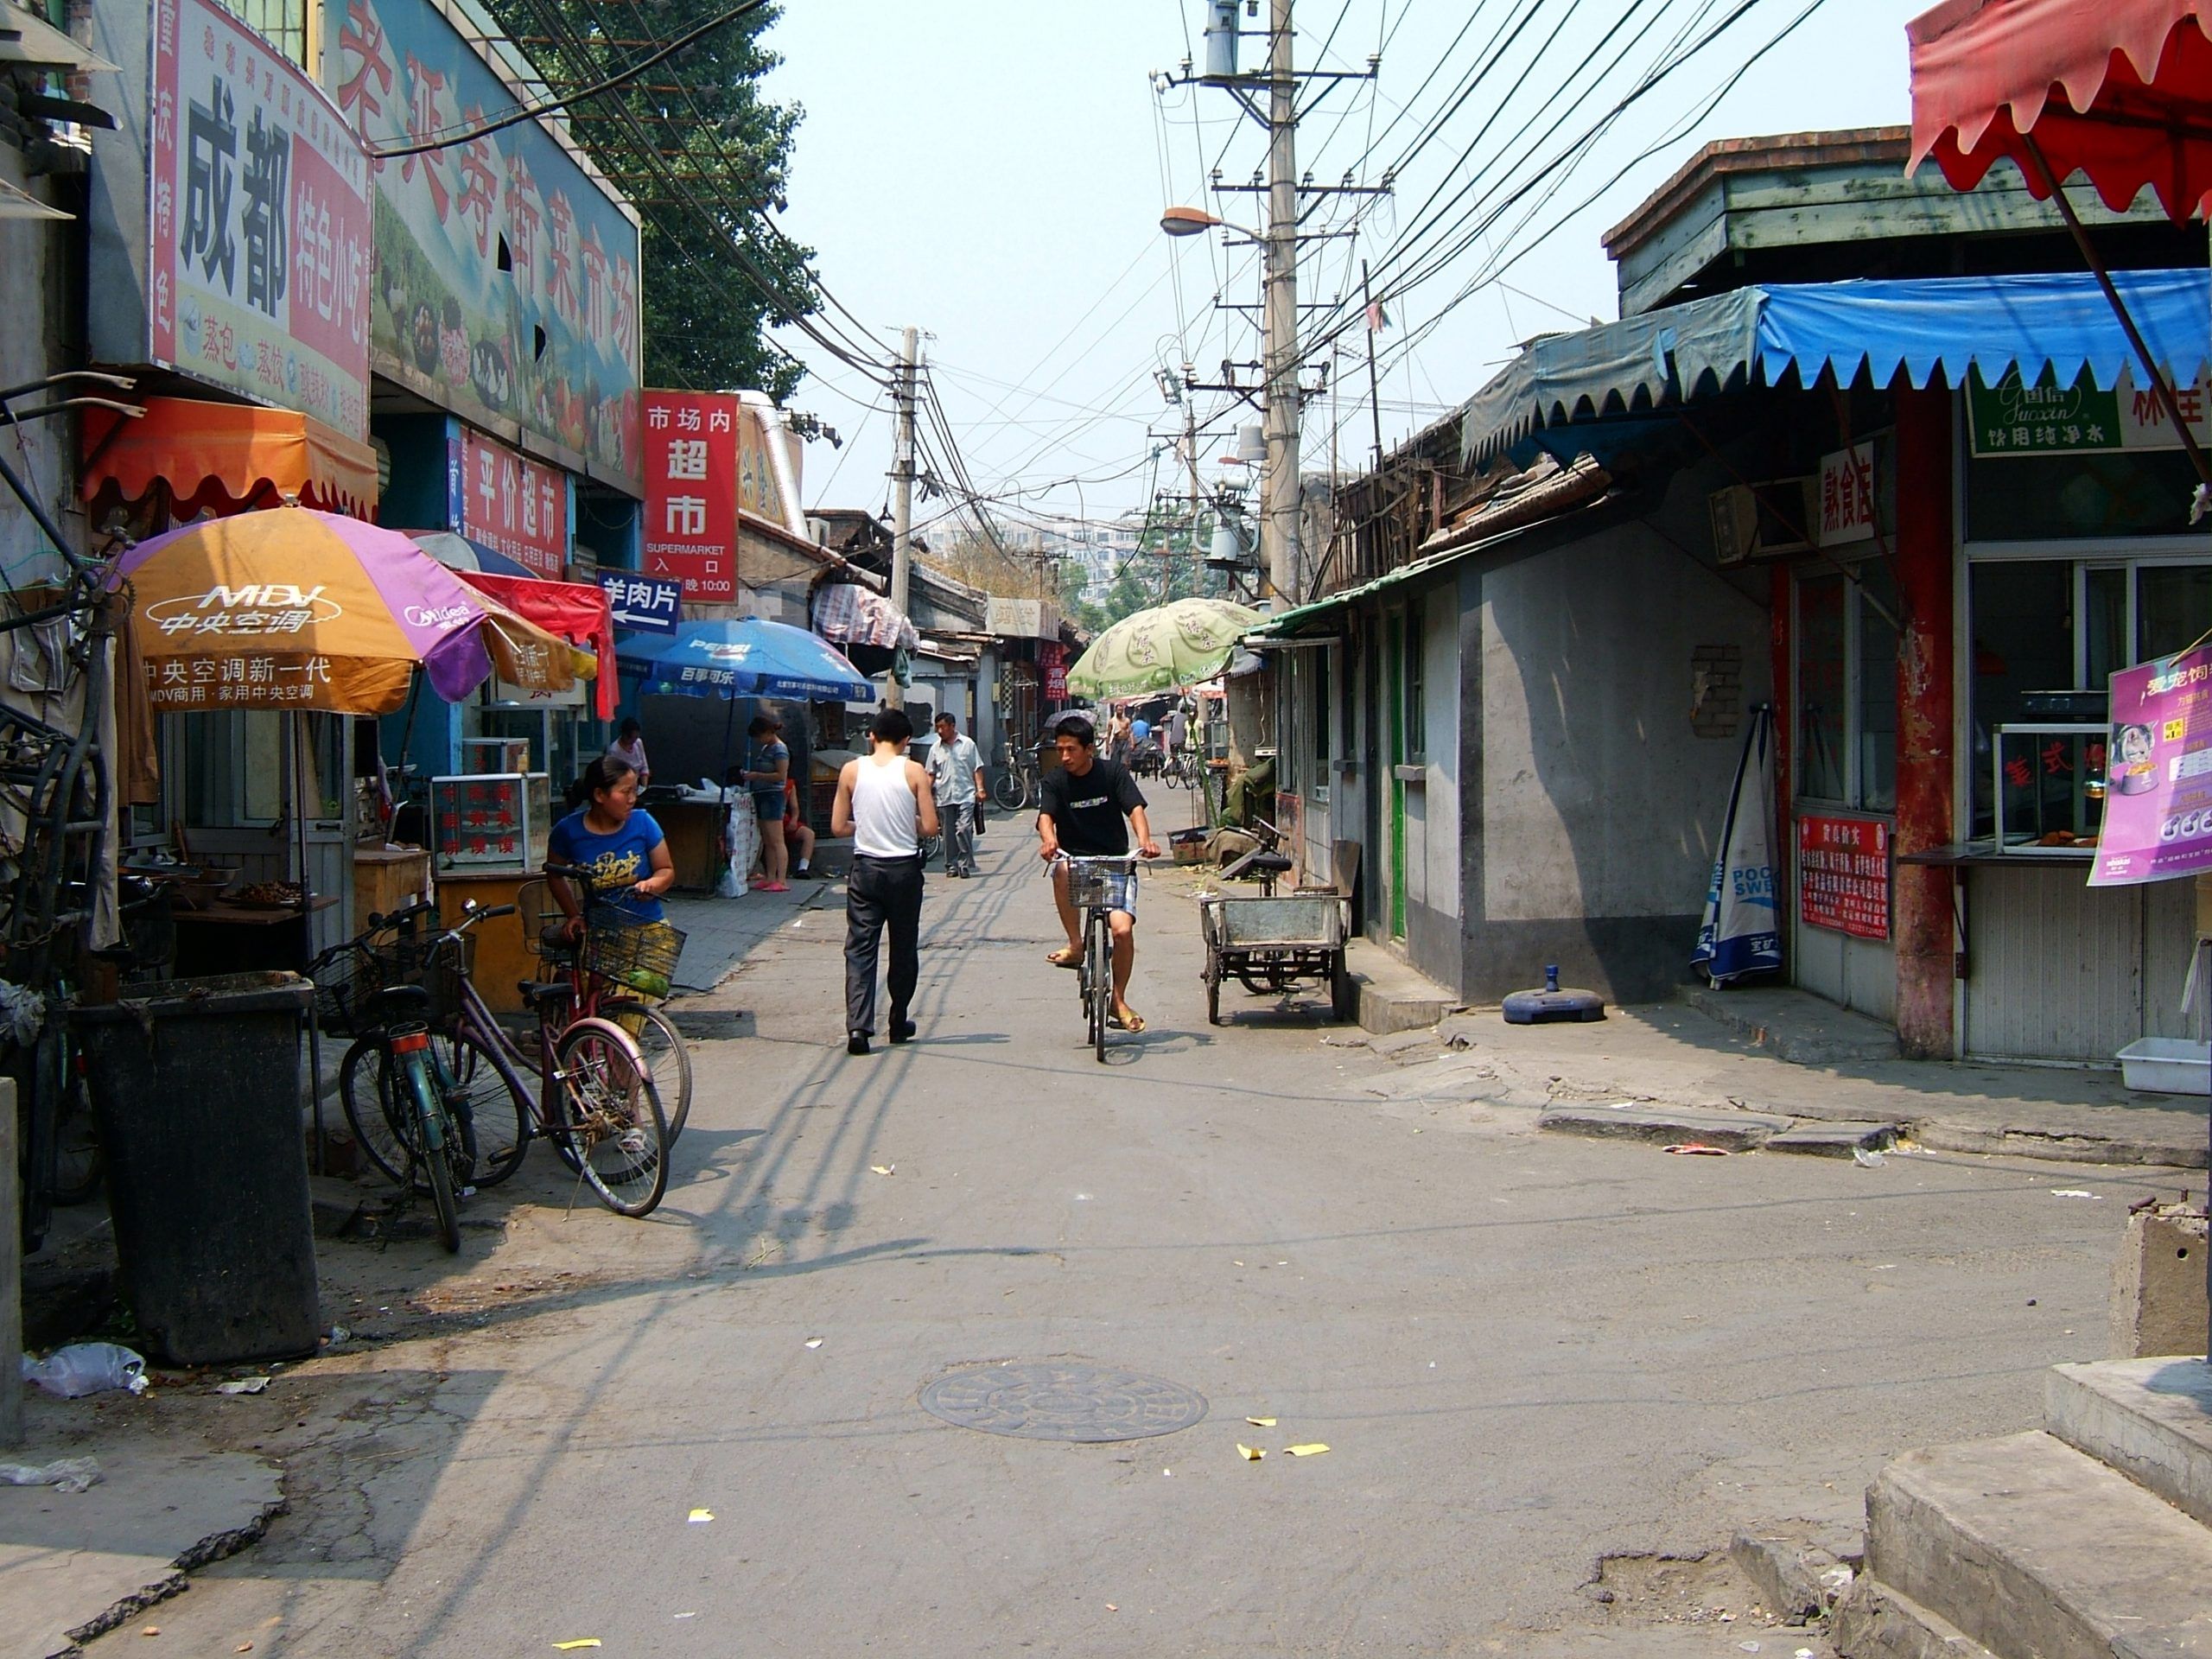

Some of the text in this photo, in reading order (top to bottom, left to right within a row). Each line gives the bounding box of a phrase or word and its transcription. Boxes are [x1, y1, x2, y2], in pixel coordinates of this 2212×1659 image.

[181, 74, 290, 317] 成都
[296, 181, 362, 345] 特色小吃
[203, 315, 237, 372] 蒸包
[648, 406, 730, 433] 市场内
[1988, 424, 2104, 448] 饮用纯净水
[480, 448, 556, 544] 平价超市
[667, 439, 708, 536] 超市
[1824, 457, 1872, 531] 熟食店
[647, 543, 725, 556] SUPERMARKET
[654, 557, 718, 573] 入口
[198, 584, 327, 609] MDV
[605, 577, 677, 612] 羊肉片
[702, 580, 730, 592] 10:00
[160, 610, 315, 636] 中央空调
[404, 604, 471, 627] Midea
[690, 639, 753, 654] PEPSI
[681, 666, 734, 684] 百事可乐
[1048, 667, 1066, 690] 香烟
[2147, 664, 2212, 697] 爱宠饲
[1823, 823, 1859, 845] 货真价实
[1736, 880, 1777, 895] SWE
